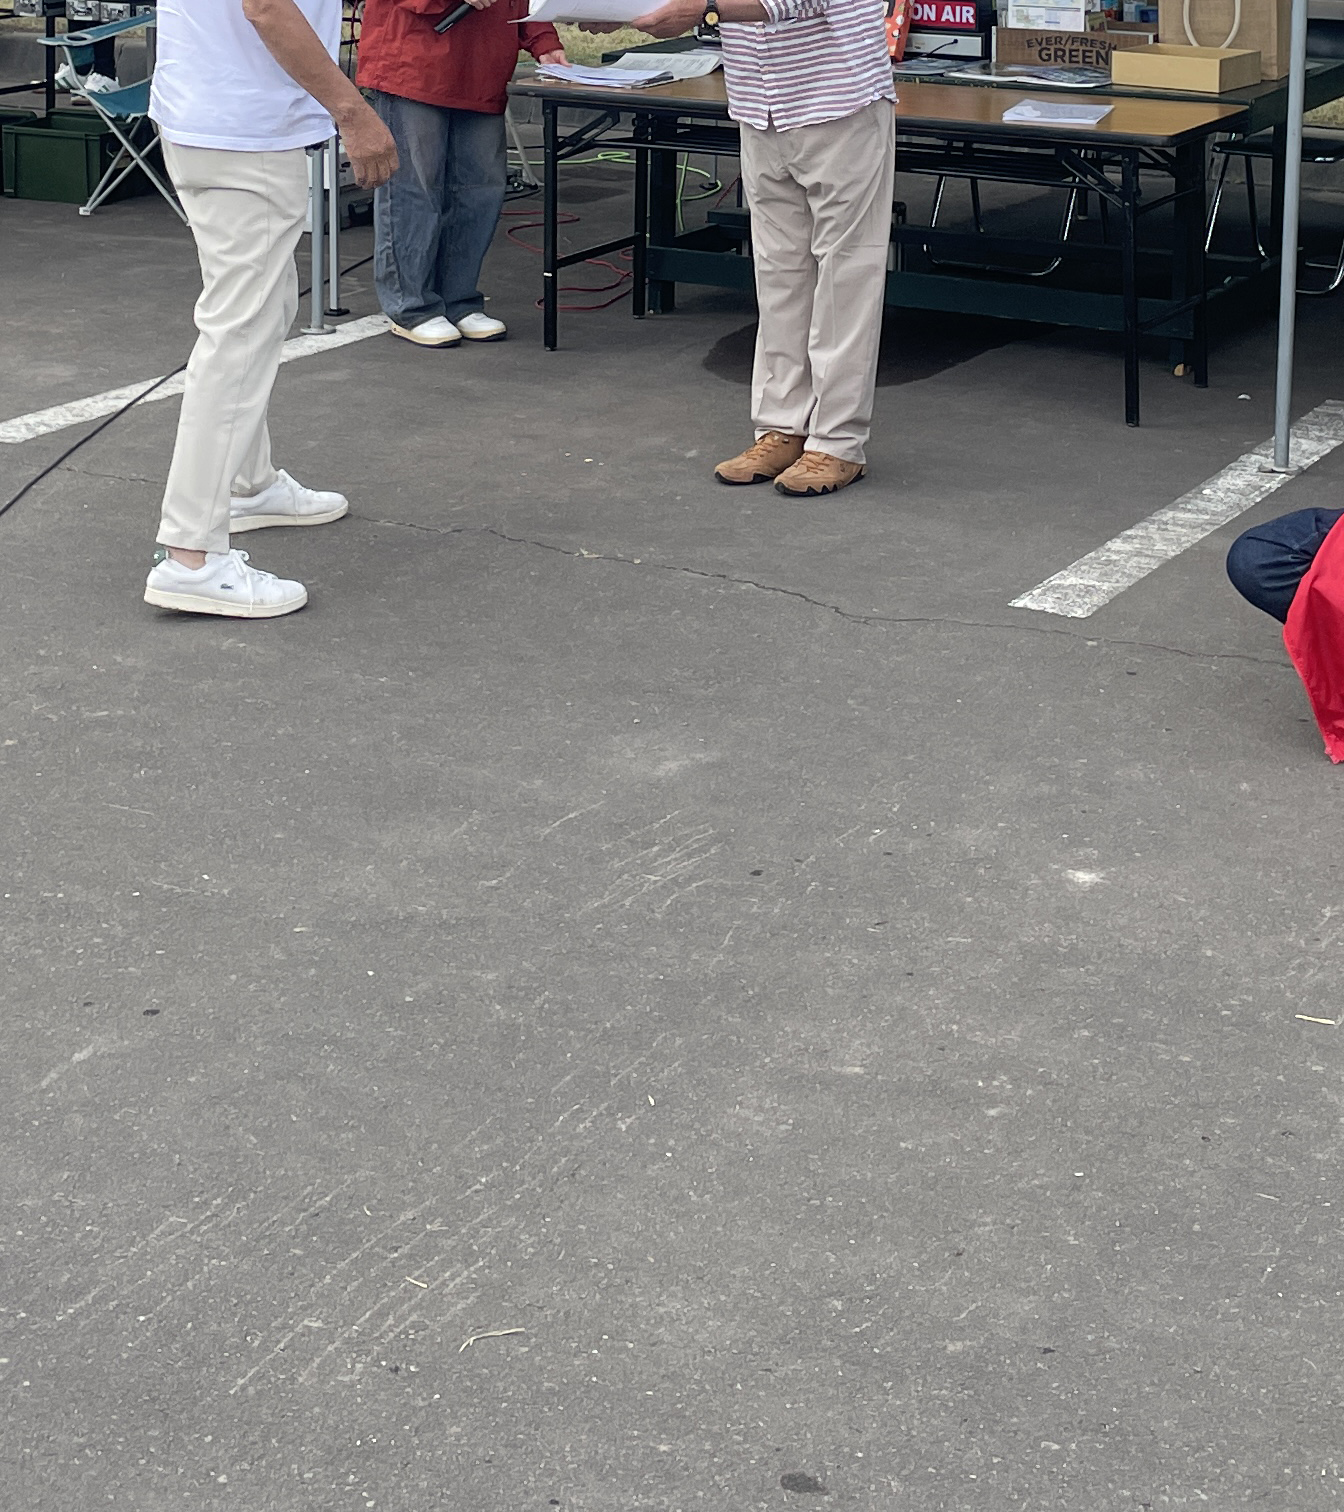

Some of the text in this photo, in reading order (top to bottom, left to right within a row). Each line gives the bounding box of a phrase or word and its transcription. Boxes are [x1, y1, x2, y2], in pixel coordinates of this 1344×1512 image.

[912, 3, 975, 24] ON AIR
[1038, 47, 1109, 66] GREEN
